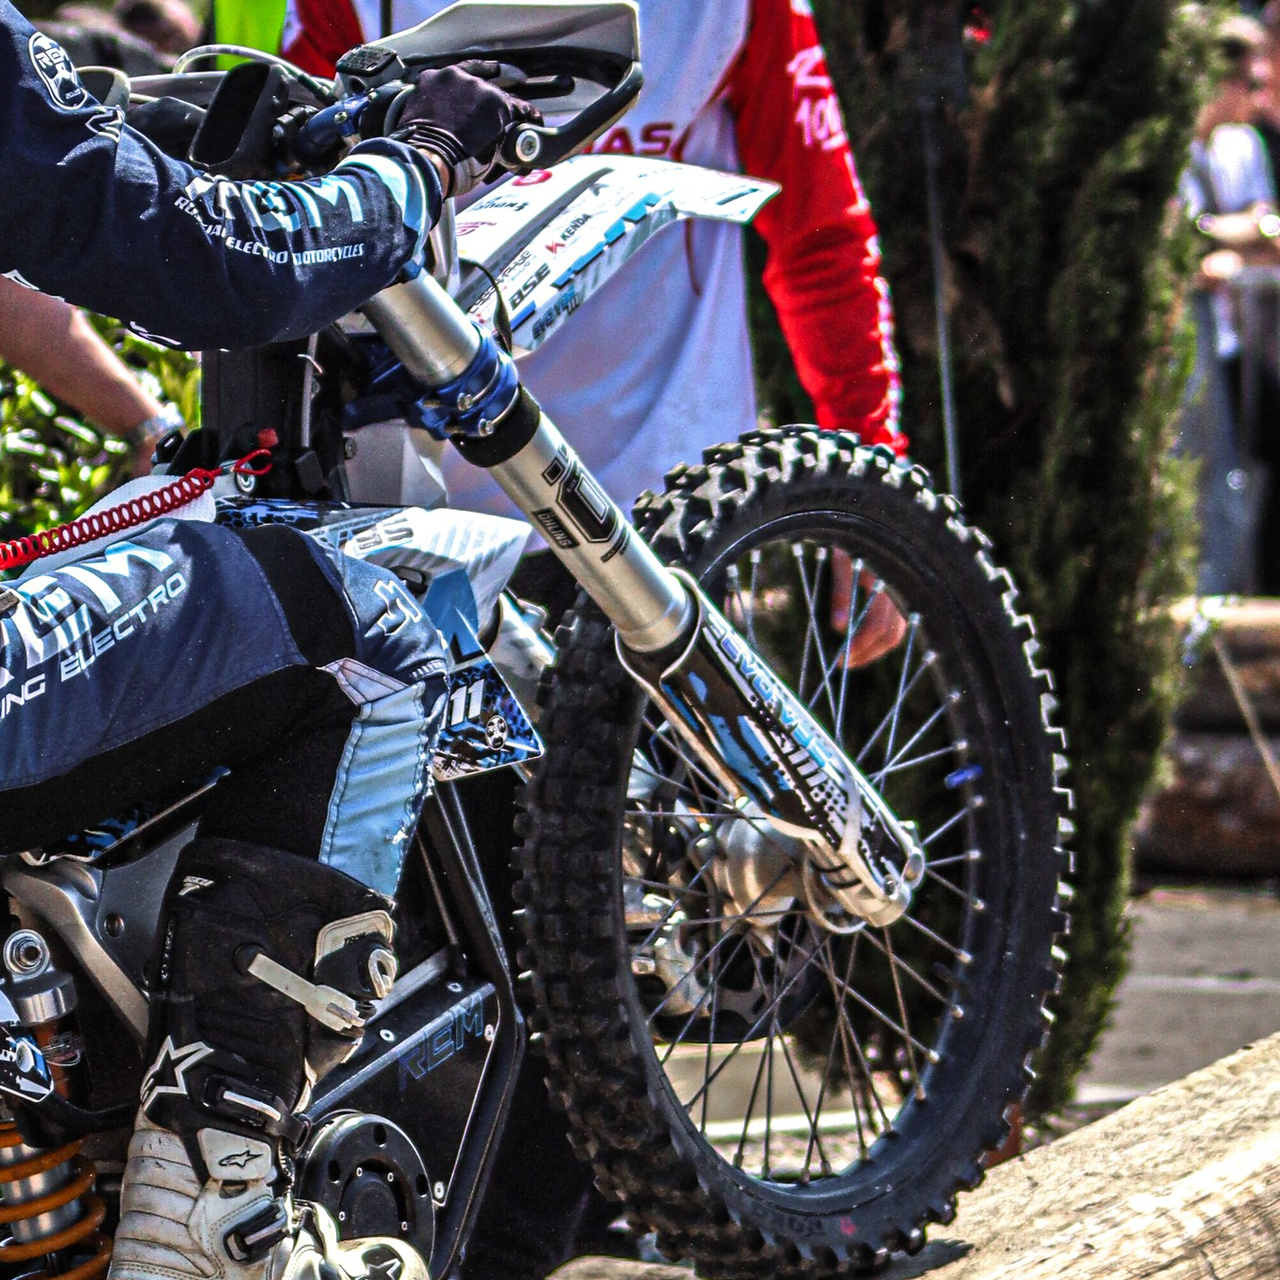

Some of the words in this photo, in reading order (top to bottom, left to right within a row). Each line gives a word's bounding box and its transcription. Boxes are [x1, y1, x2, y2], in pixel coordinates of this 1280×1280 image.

[559, 213, 593, 241] KENDA
[225, 237, 289, 265] ELECTRO
[510, 262, 552, 310] BSE
[60, 572, 187, 682] ELECTRO
